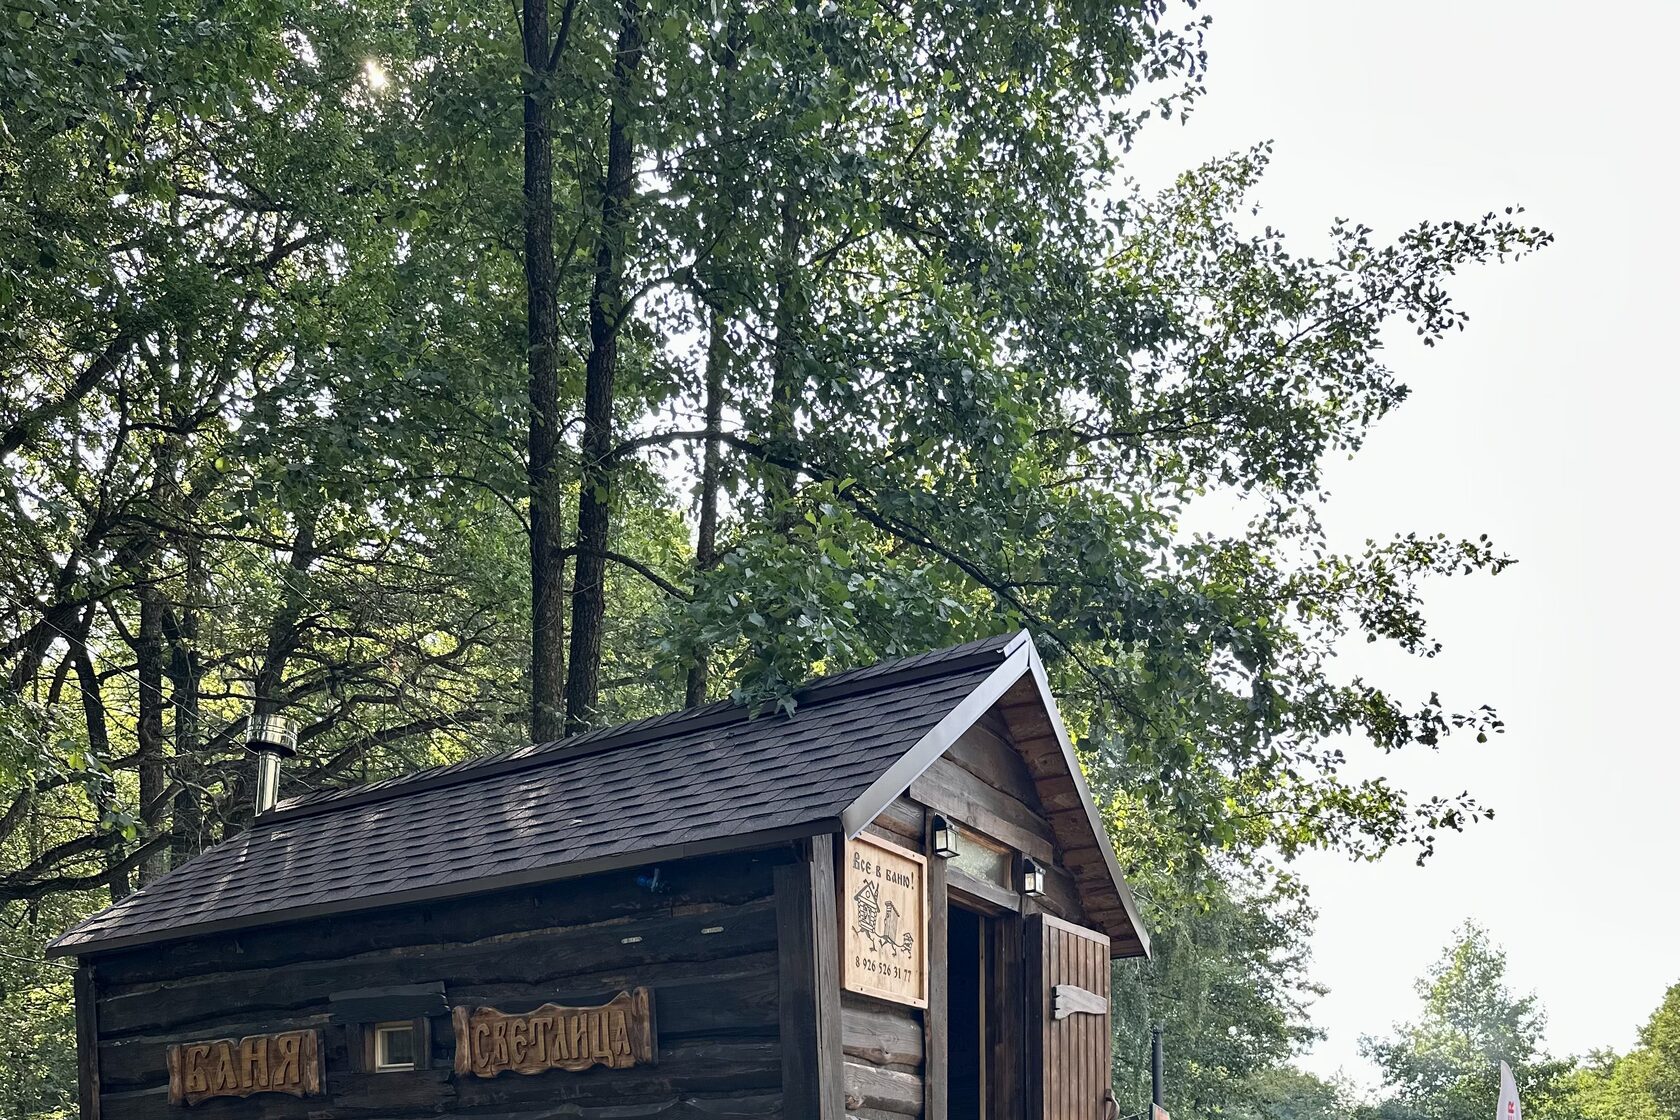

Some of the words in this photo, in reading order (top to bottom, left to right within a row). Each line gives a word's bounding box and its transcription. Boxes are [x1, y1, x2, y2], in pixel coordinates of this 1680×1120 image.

[855, 956, 860, 968] 8
[862, 958, 876, 973] 926
[878, 963, 892, 977] 526
[894, 967, 902, 979] 31
[903, 969, 912, 983] 77
[184, 1036, 303, 1093] БАНЯ
[474, 1010, 632, 1068] СВЕТЛИЦА
